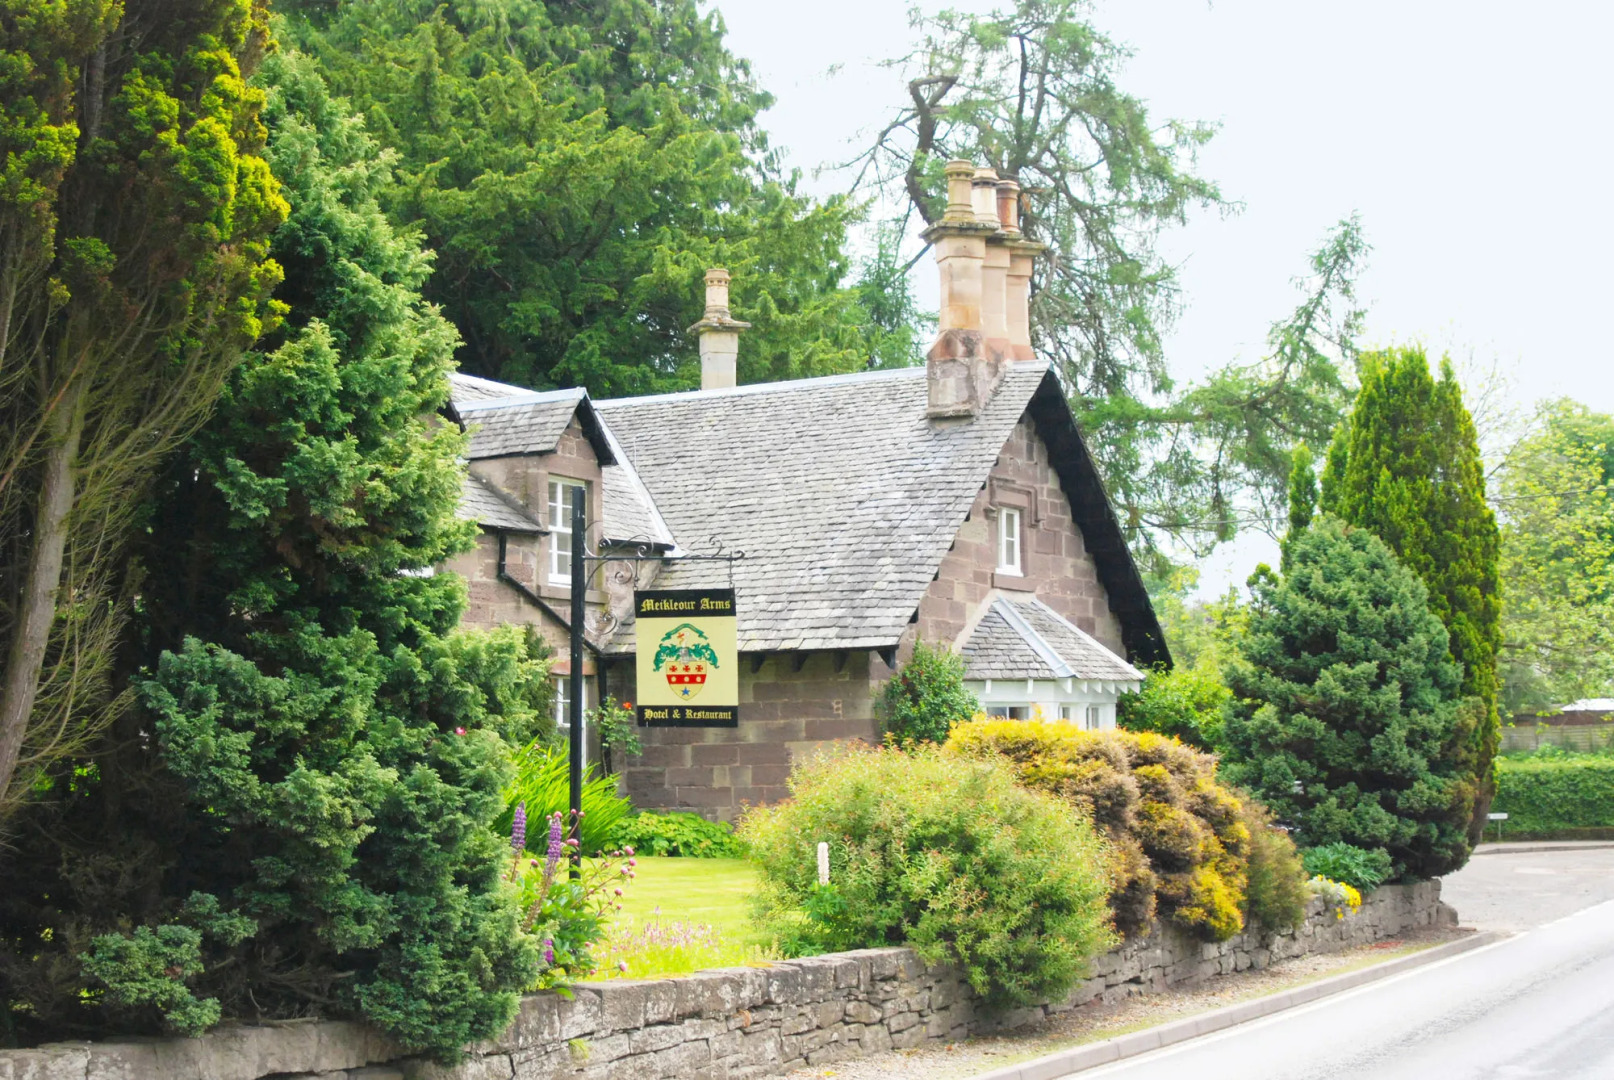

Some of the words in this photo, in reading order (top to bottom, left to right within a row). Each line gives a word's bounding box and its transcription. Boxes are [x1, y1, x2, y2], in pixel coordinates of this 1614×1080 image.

[641, 599, 695, 612] Meikleour
[700, 598, 731, 610] Arms
[644, 708, 669, 720] Hotel
[672, 708, 681, 719] &
[685, 708, 732, 720] Restaurant
